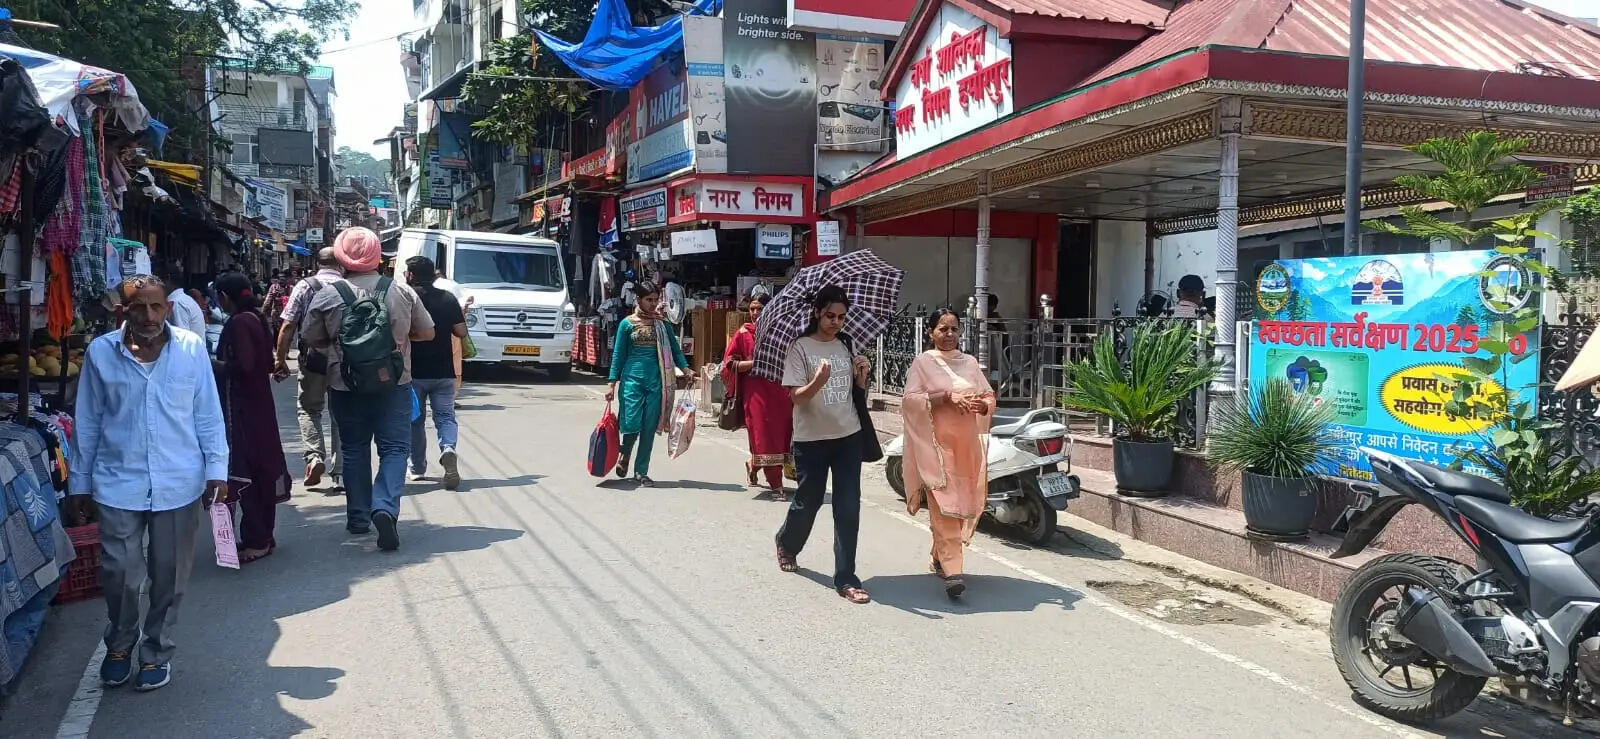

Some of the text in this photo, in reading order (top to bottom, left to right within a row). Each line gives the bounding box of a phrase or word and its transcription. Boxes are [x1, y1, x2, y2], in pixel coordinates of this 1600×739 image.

[738, 12, 788, 26] Lights wit
[738, 26, 804, 40] brighter side.
[649, 81, 688, 129] HAVEL
[895, 61, 1011, 134] नगर निगम हमीरपुर
[706, 189, 741, 209] नगर
[752, 186, 793, 211] निगम
[1257, 320, 1327, 346] स्वच्छता
[1330, 312, 1409, 351] सर्वेक्षण
[1402, 376, 1438, 393] प्रयास
[1393, 396, 1442, 416] सहयोग
[1366, 433, 1398, 449] आपसे
[1402, 434, 1438, 454] निवेदन
